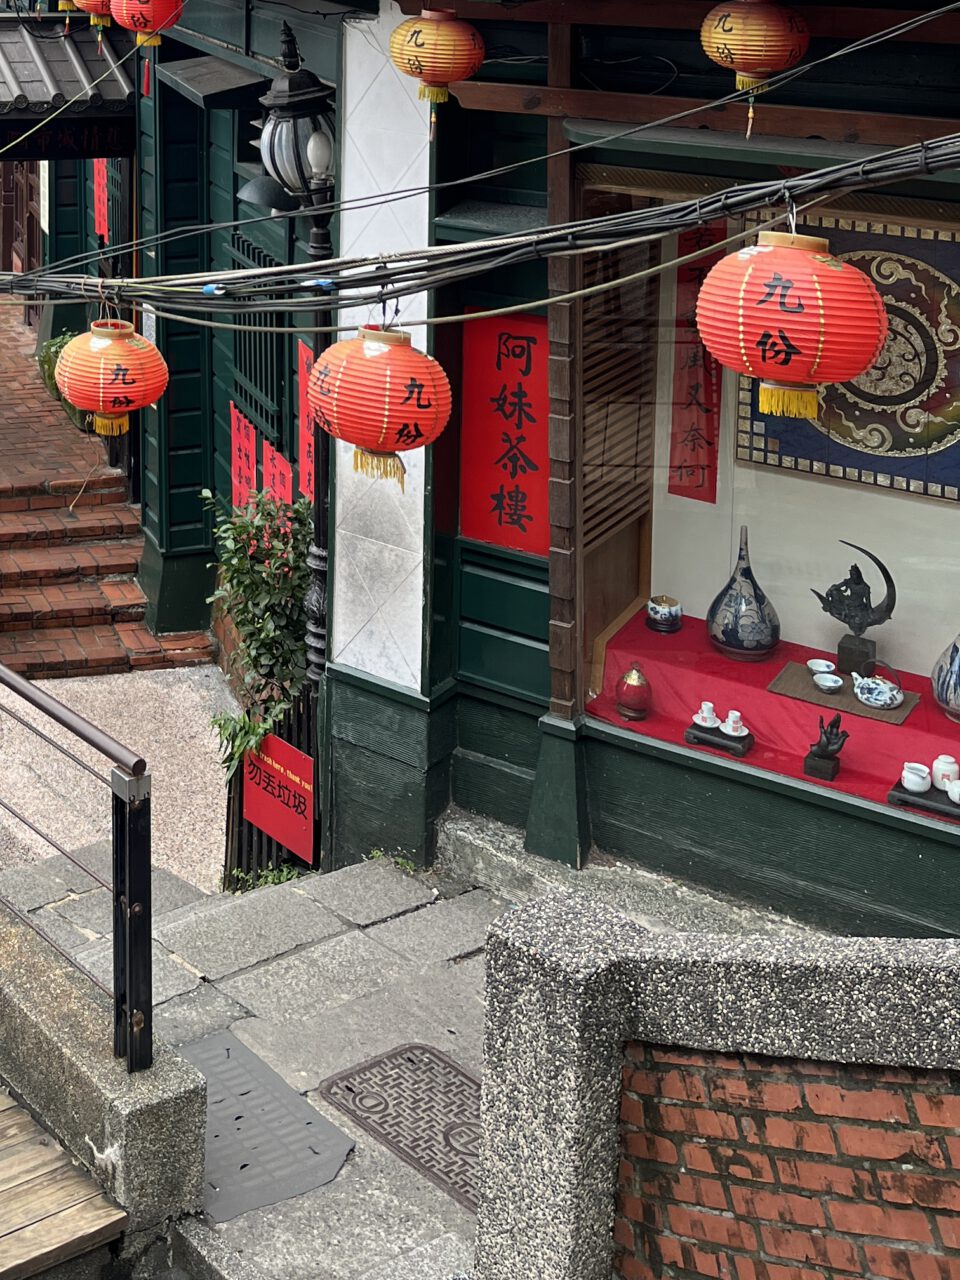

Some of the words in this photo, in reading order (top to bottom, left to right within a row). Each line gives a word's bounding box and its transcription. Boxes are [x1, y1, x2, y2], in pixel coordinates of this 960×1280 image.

[407, 29, 424, 75] 九份
[714, 13, 737, 64] 九份
[754, 271, 806, 368] 九份
[108, 363, 137, 409] 九份
[394, 376, 432, 446] 九份
[489, 332, 540, 534] 阿妹茶樓
